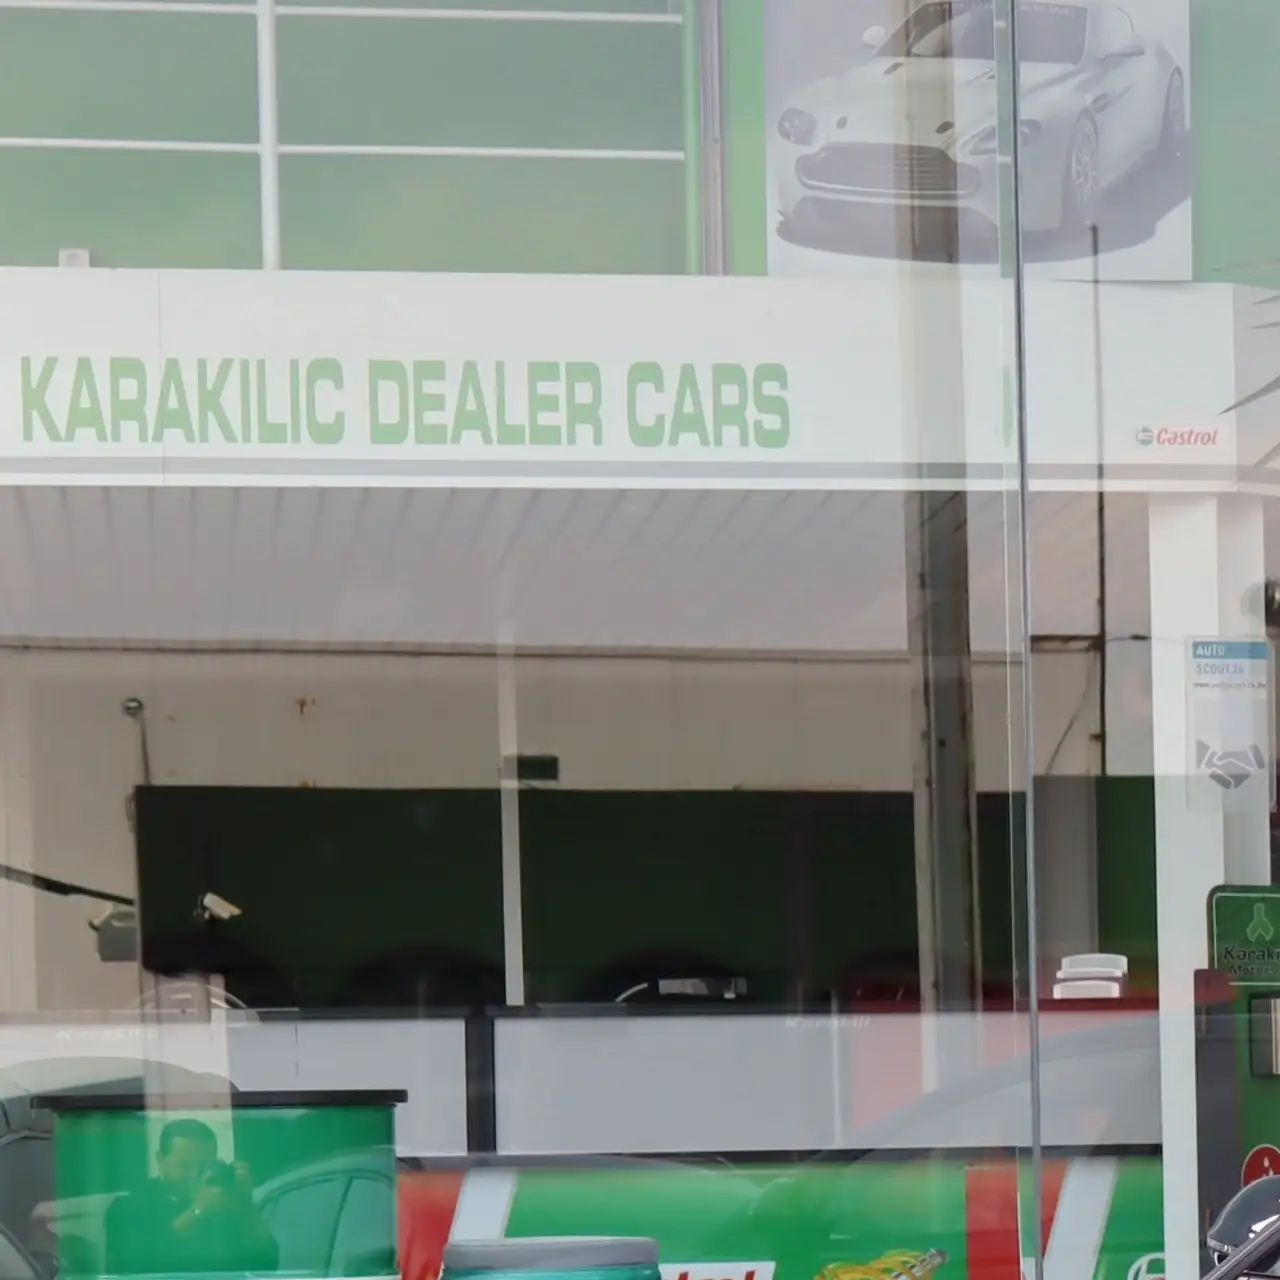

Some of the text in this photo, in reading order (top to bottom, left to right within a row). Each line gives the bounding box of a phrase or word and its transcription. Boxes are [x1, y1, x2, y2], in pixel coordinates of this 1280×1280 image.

[21, 356, 790, 448] KARAKILIC DEALER CARS
[1156, 428, 1218, 446] Castrol
